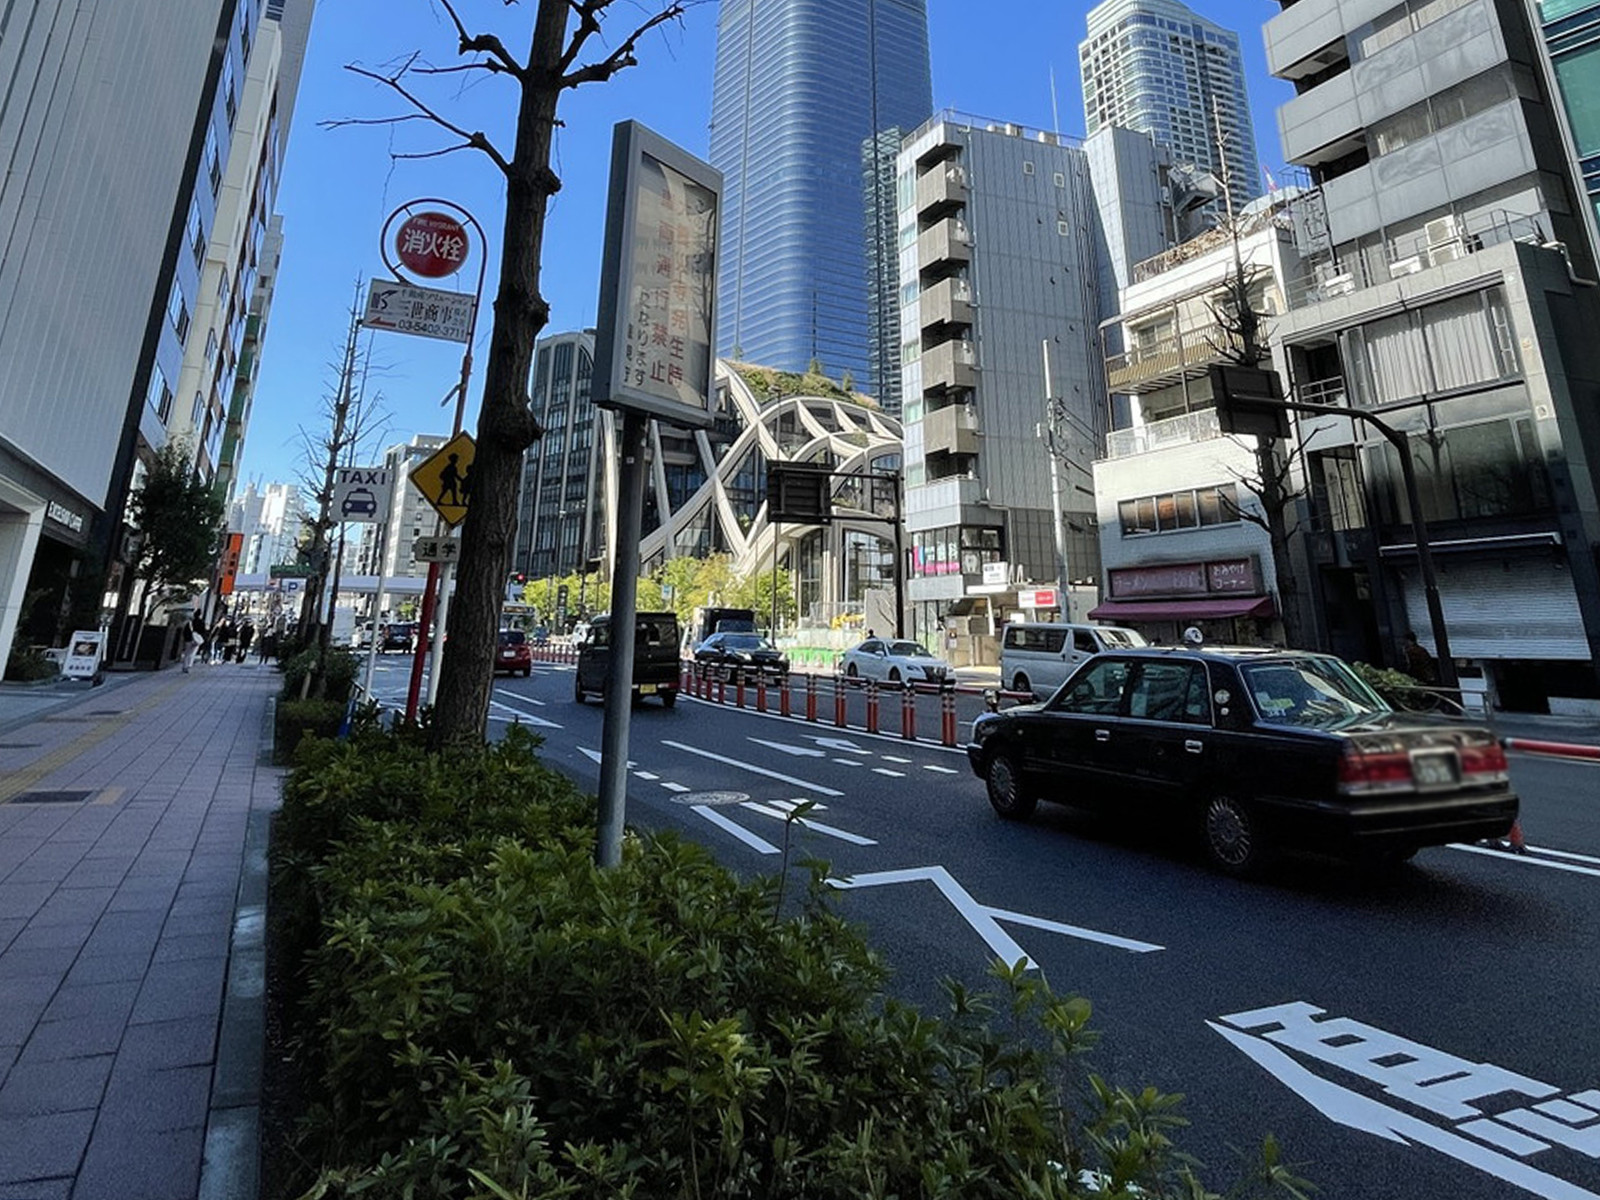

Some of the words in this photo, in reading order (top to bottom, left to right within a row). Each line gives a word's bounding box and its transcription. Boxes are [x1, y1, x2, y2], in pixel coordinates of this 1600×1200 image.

[402, 228, 463, 262] 消火栓
[399, 319, 465, 338] 03-5402-3711
[340, 470, 387, 485] TAXI
[288, 582, 298, 592] P
[1215, 578, 1246, 589] コーナー
